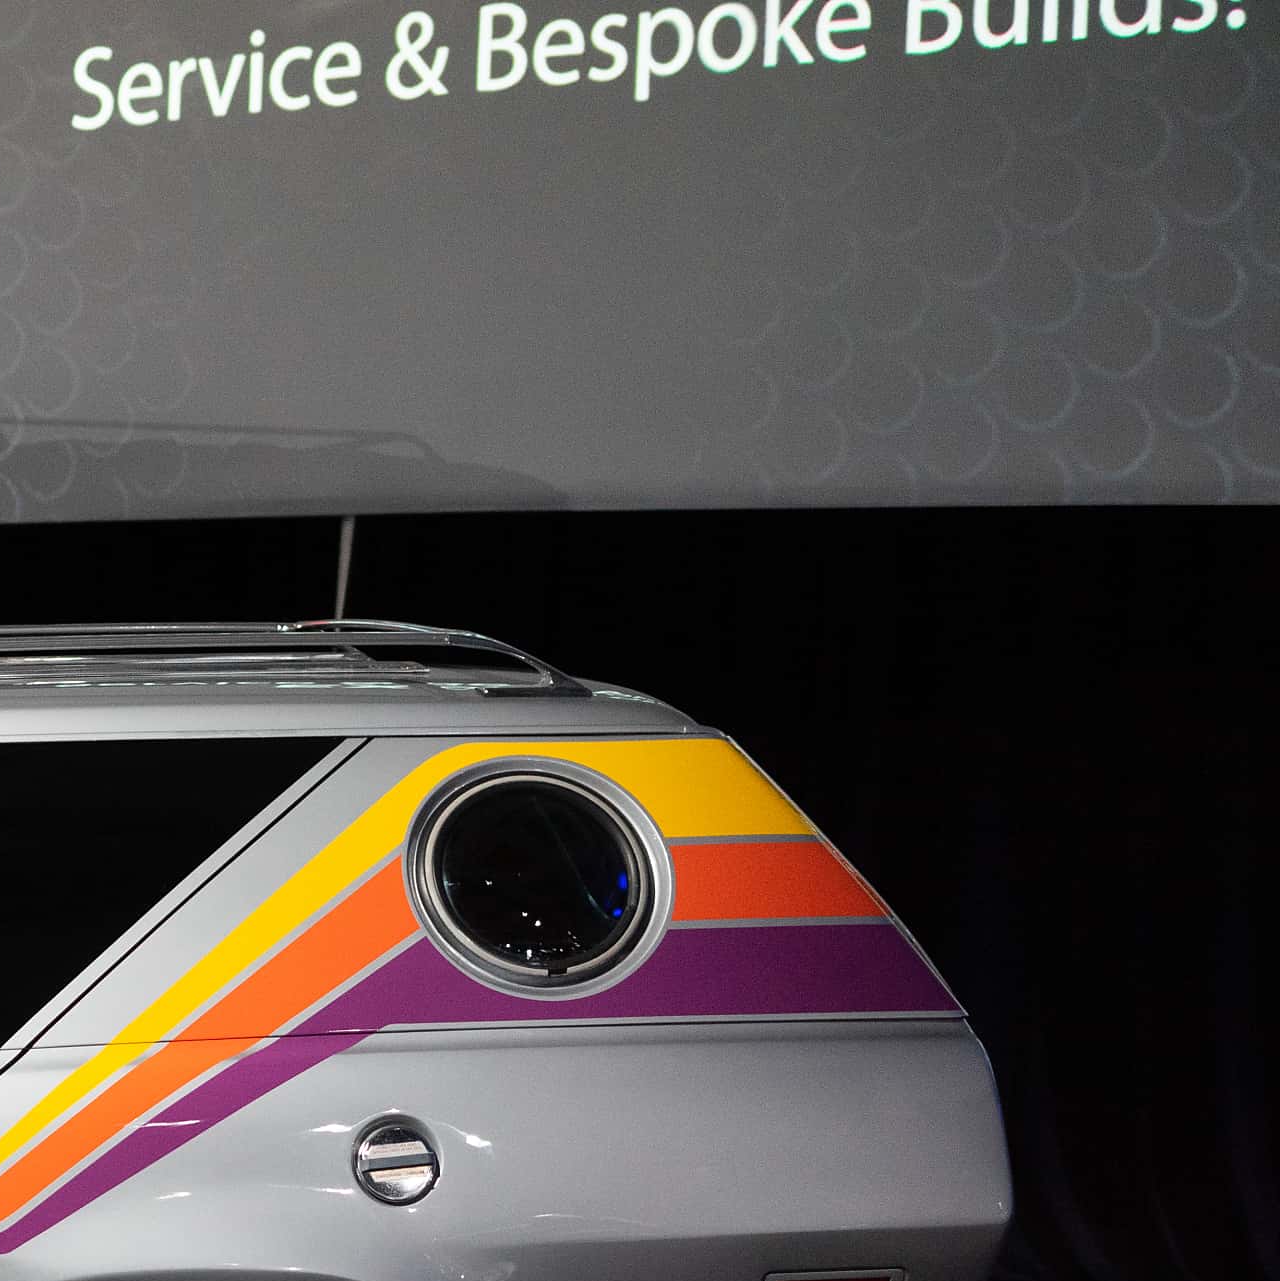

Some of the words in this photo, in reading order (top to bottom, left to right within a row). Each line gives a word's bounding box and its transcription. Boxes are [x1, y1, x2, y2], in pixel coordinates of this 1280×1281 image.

[72, 29, 362, 131] Service
[385, 10, 450, 100] &
[476, 2, 872, 102] Bespoke
